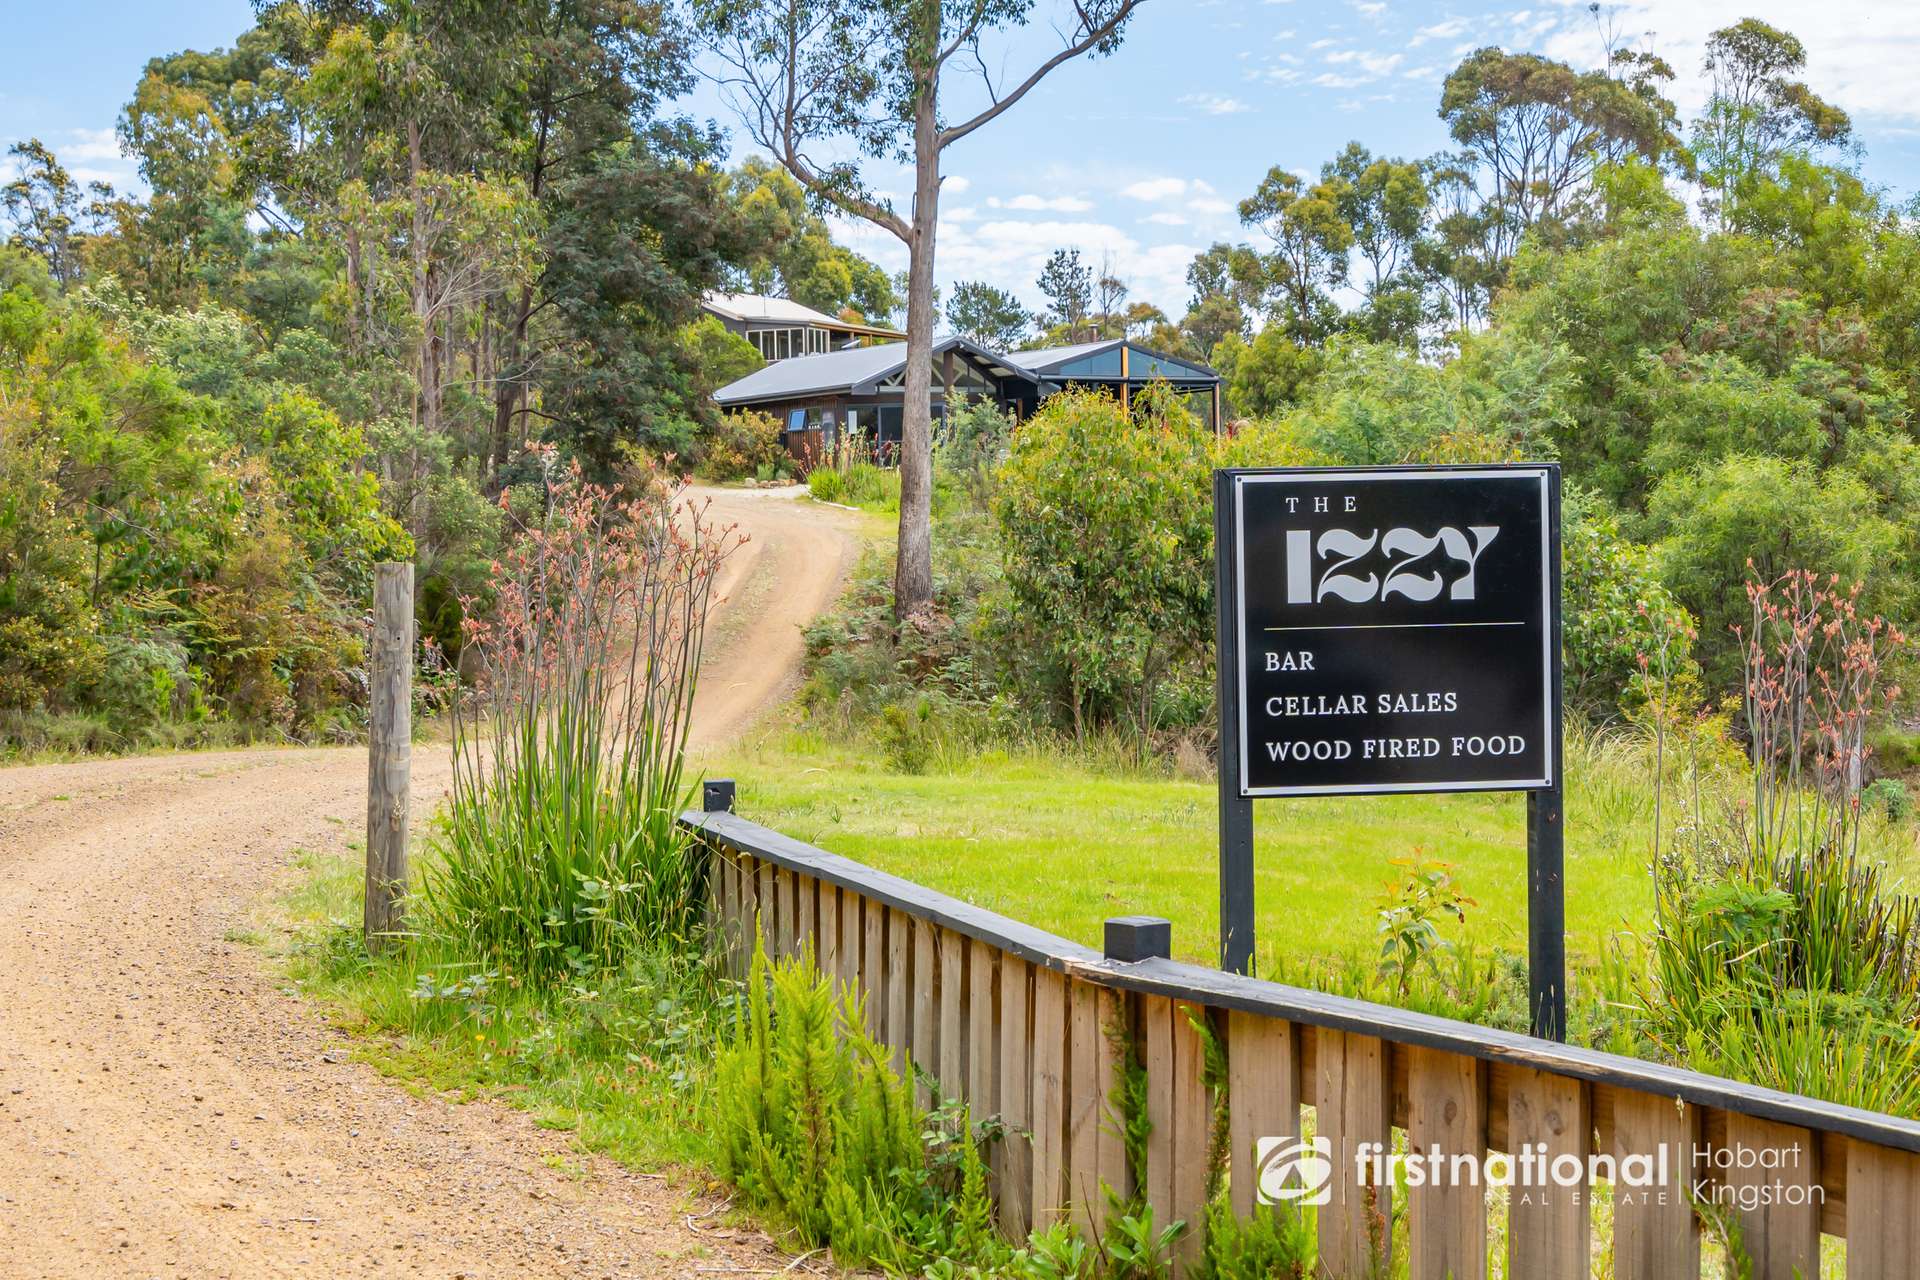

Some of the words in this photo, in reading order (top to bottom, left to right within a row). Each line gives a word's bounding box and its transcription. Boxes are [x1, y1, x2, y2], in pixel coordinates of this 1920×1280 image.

[1285, 496, 1357, 513] THE
[1286, 526, 1500, 604] IZZY
[1265, 651, 1315, 671] BAR
[1266, 695, 1368, 717] CELLAR
[1378, 692, 1458, 714] SALES
[1266, 740, 1351, 762] WOOD
[1362, 737, 1441, 759] FIRED
[1452, 735, 1526, 756] FOOD
